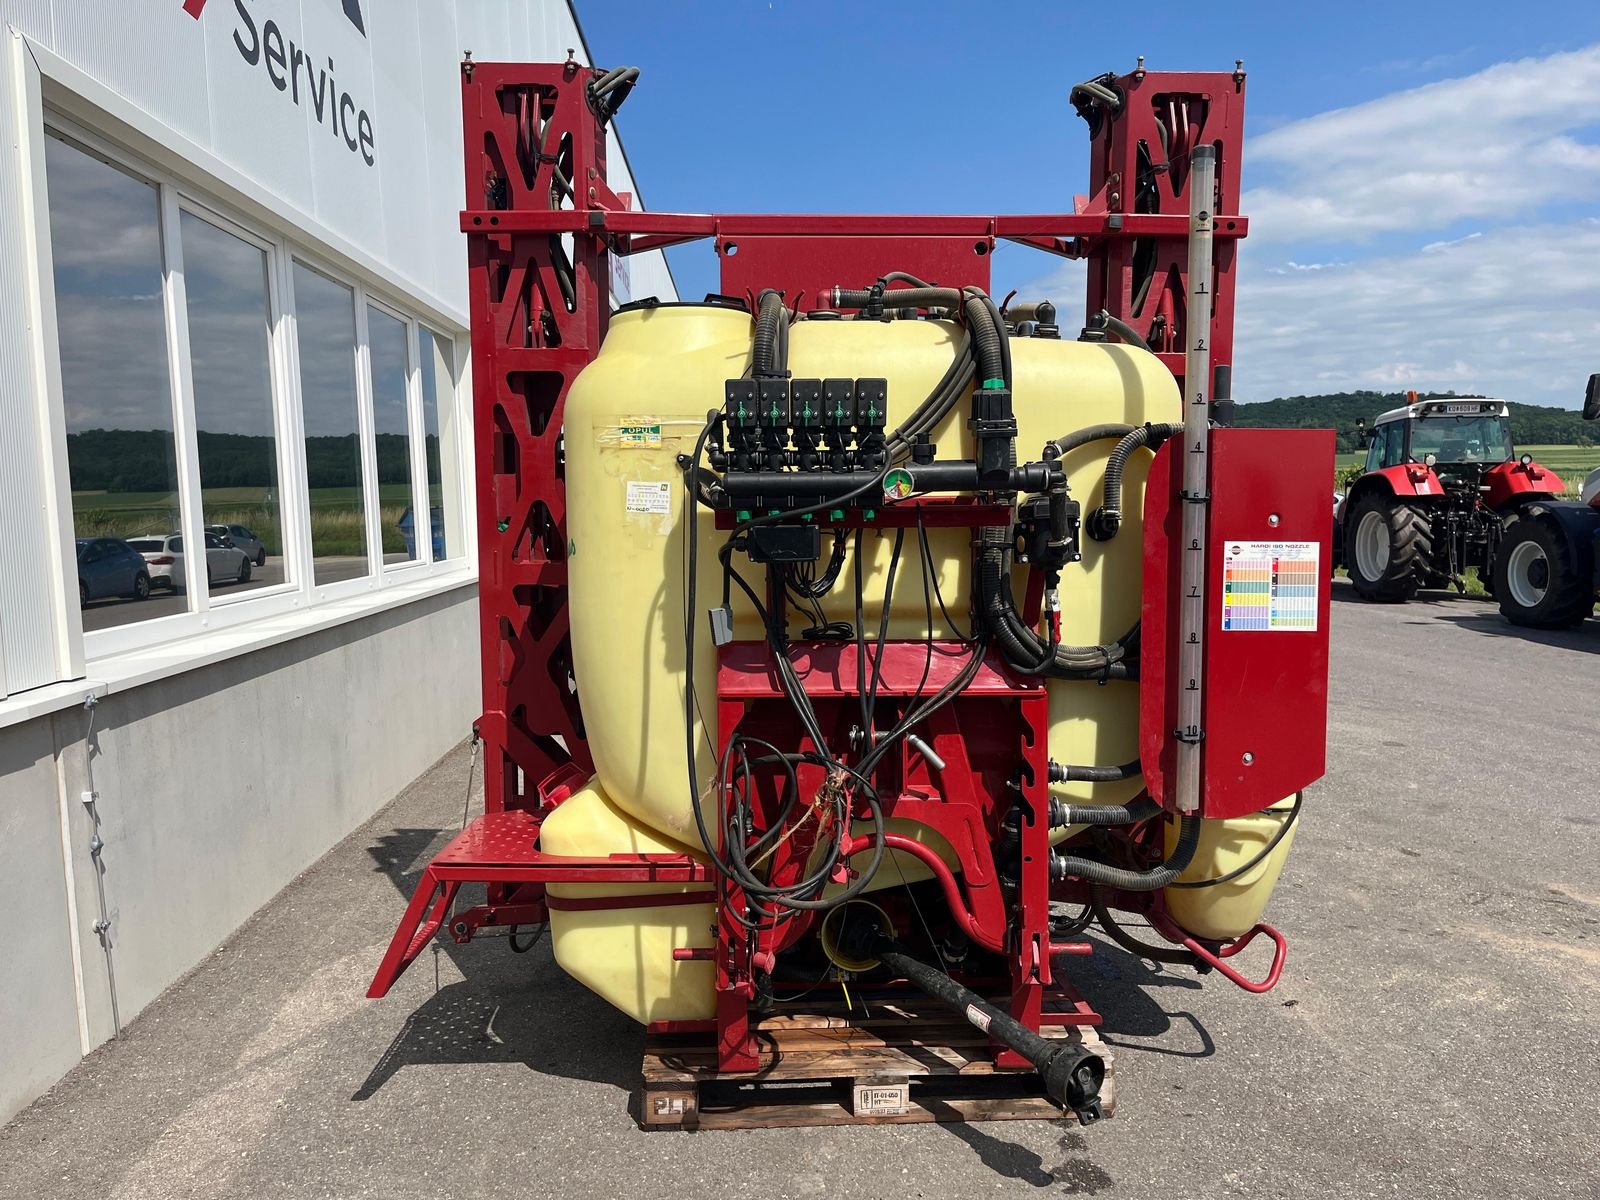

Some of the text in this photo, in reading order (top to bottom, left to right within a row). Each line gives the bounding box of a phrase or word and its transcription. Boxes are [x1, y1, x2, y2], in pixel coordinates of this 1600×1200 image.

[232, 0, 375, 167] Service
[1199, 282, 1205, 292] 1
[1198, 339, 1204, 349] 2
[1196, 393, 1203, 403] 3
[628, 426, 654, 434] OPUL
[1194, 441, 1201, 451] 4
[1192, 539, 1198, 549] 6
[1191, 586, 1197, 596] 7
[1190, 632, 1196, 642] 8
[1189, 679, 1196, 688] 9
[1186, 725, 1198, 735] 10
